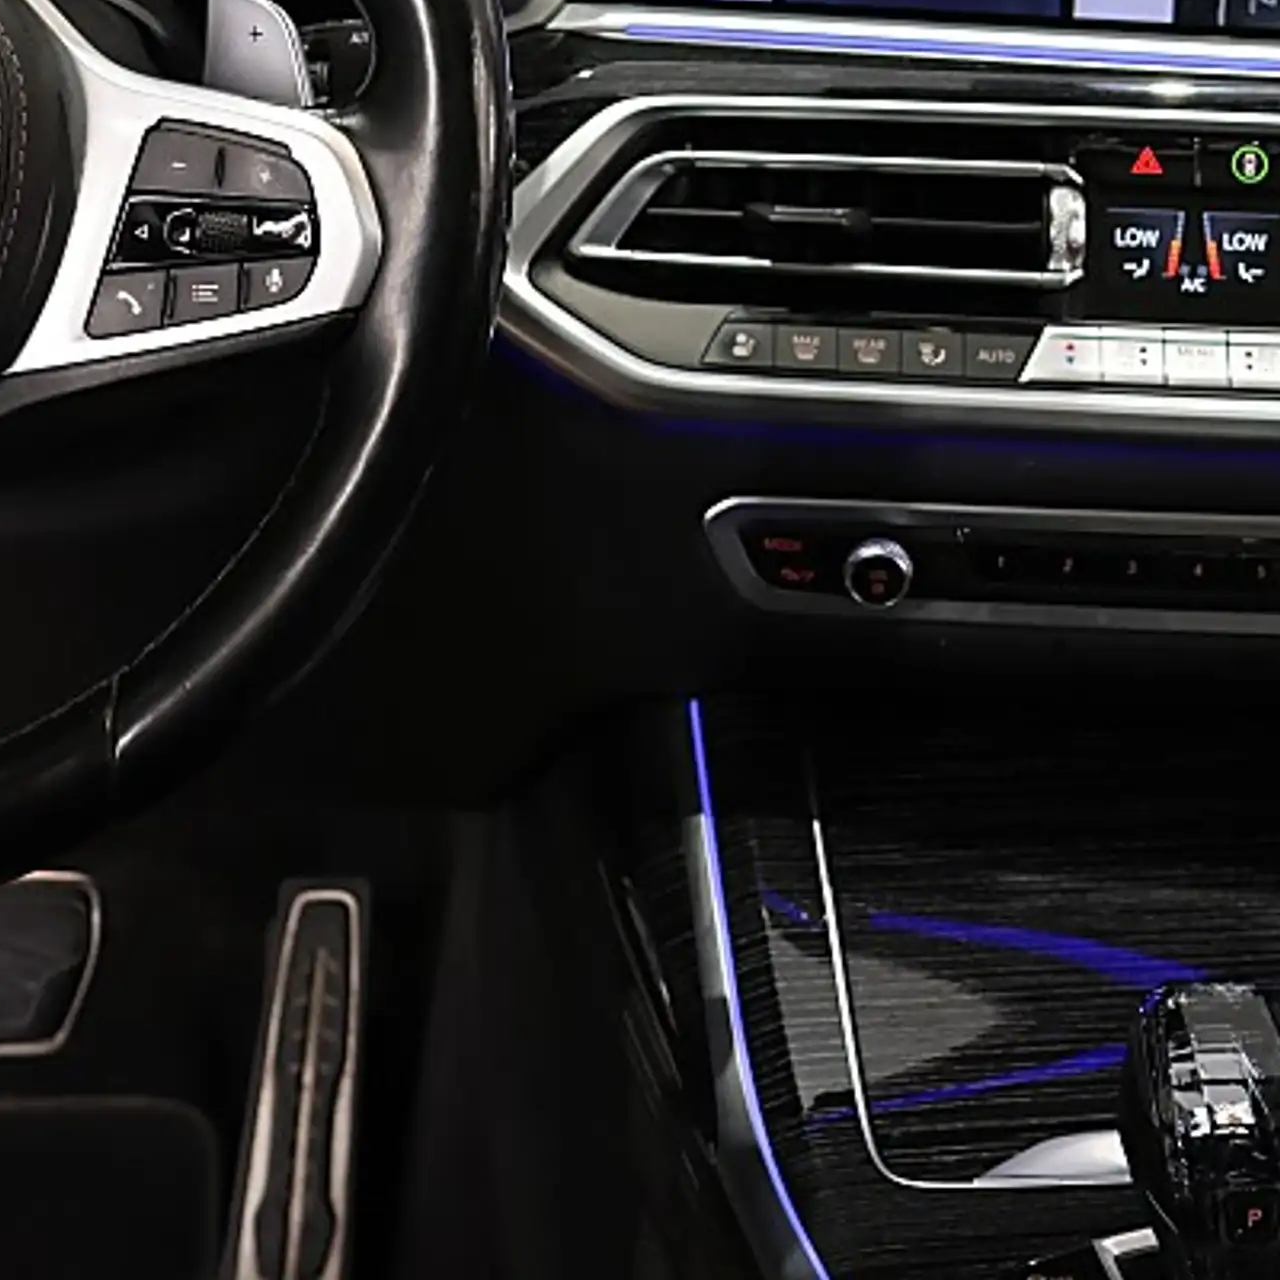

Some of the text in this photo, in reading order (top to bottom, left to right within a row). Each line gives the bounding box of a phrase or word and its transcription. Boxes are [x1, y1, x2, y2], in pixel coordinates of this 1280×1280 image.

[1114, 227, 1161, 248] LOW
[1222, 232, 1269, 252] LOW
[976, 349, 1016, 365] AUTO
[1247, 1208, 1263, 1228] P
